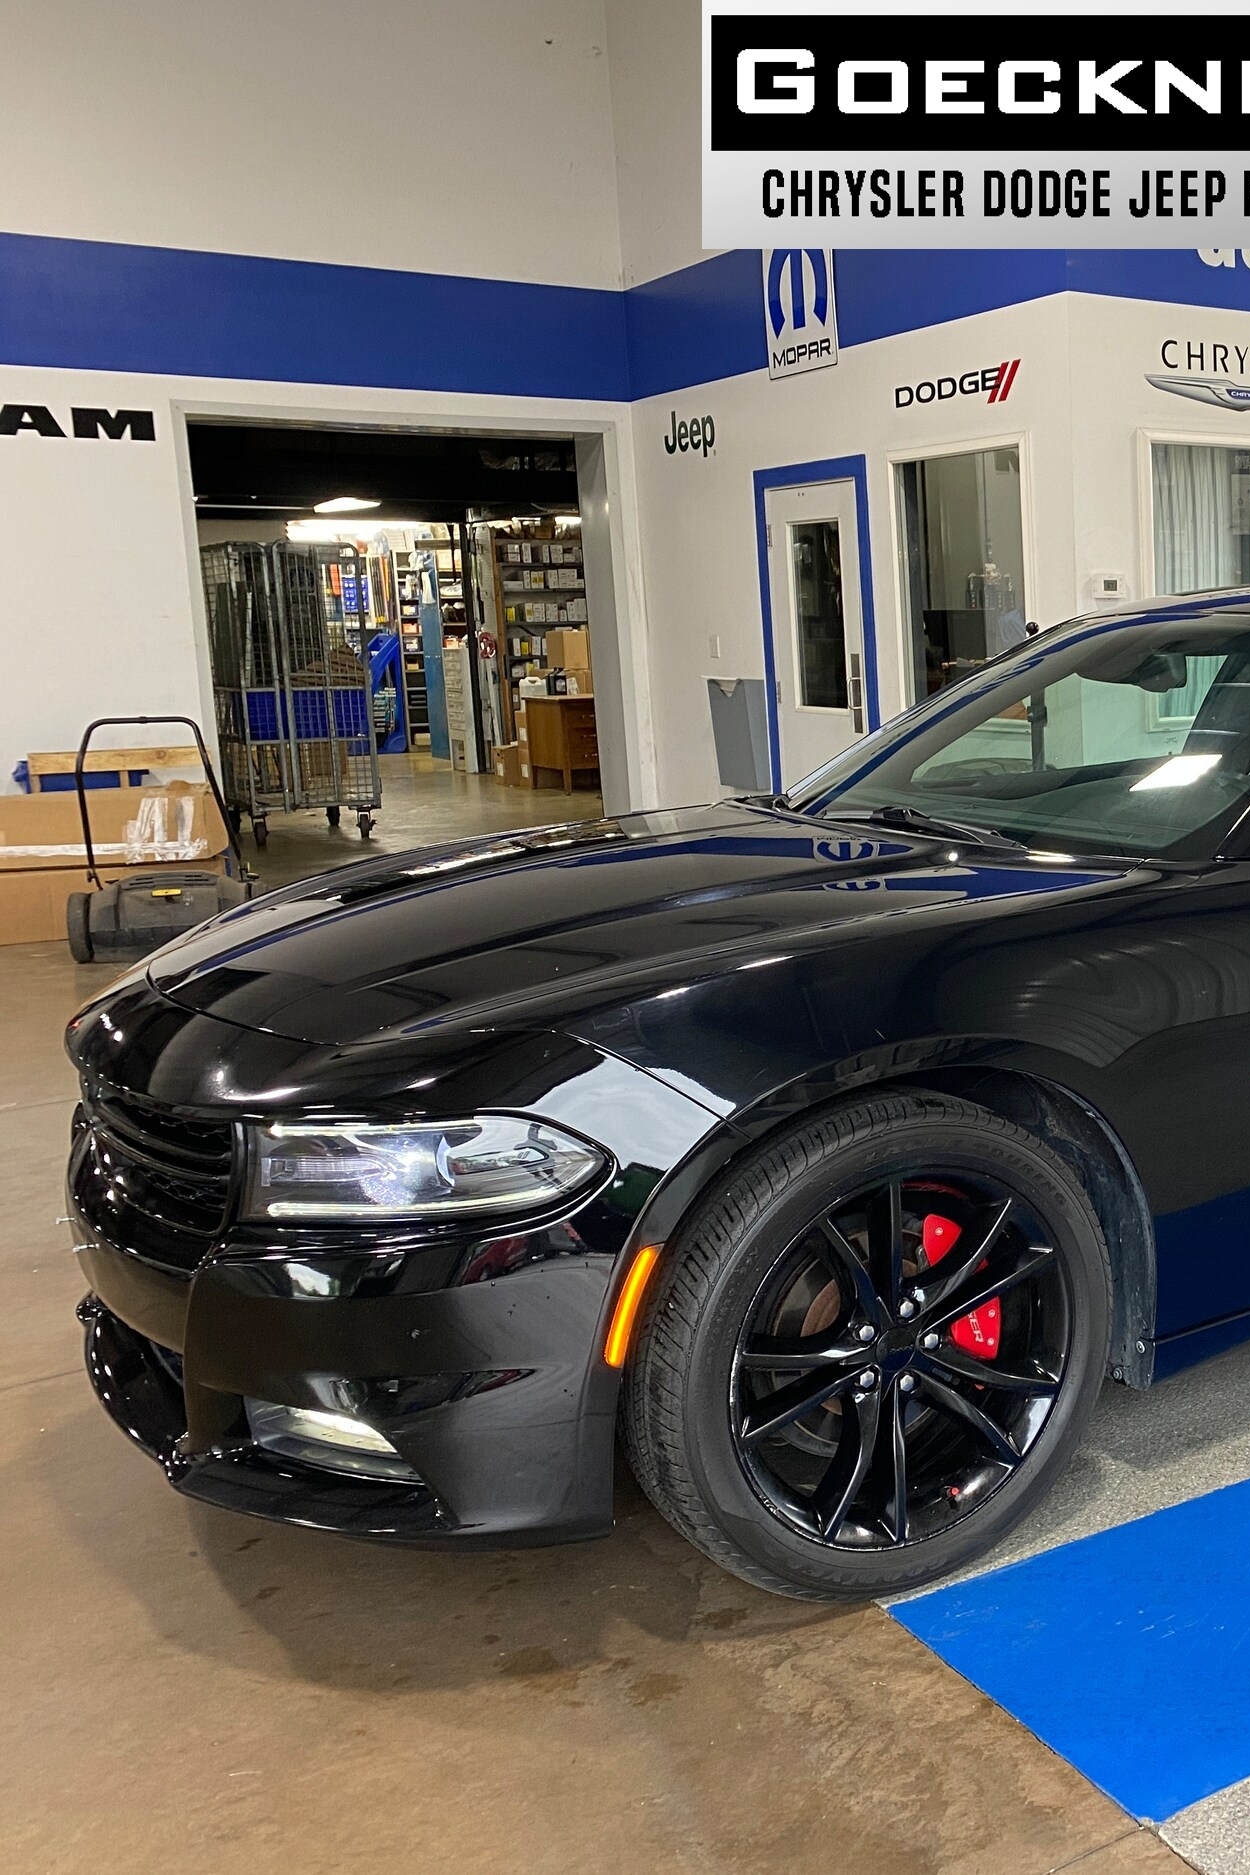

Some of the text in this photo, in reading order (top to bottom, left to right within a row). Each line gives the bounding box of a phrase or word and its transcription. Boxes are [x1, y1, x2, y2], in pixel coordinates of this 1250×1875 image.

[772, 338, 832, 370] MOPAR
[894, 366, 1003, 409] DODGE
[664, 410, 715, 458] Jeep
